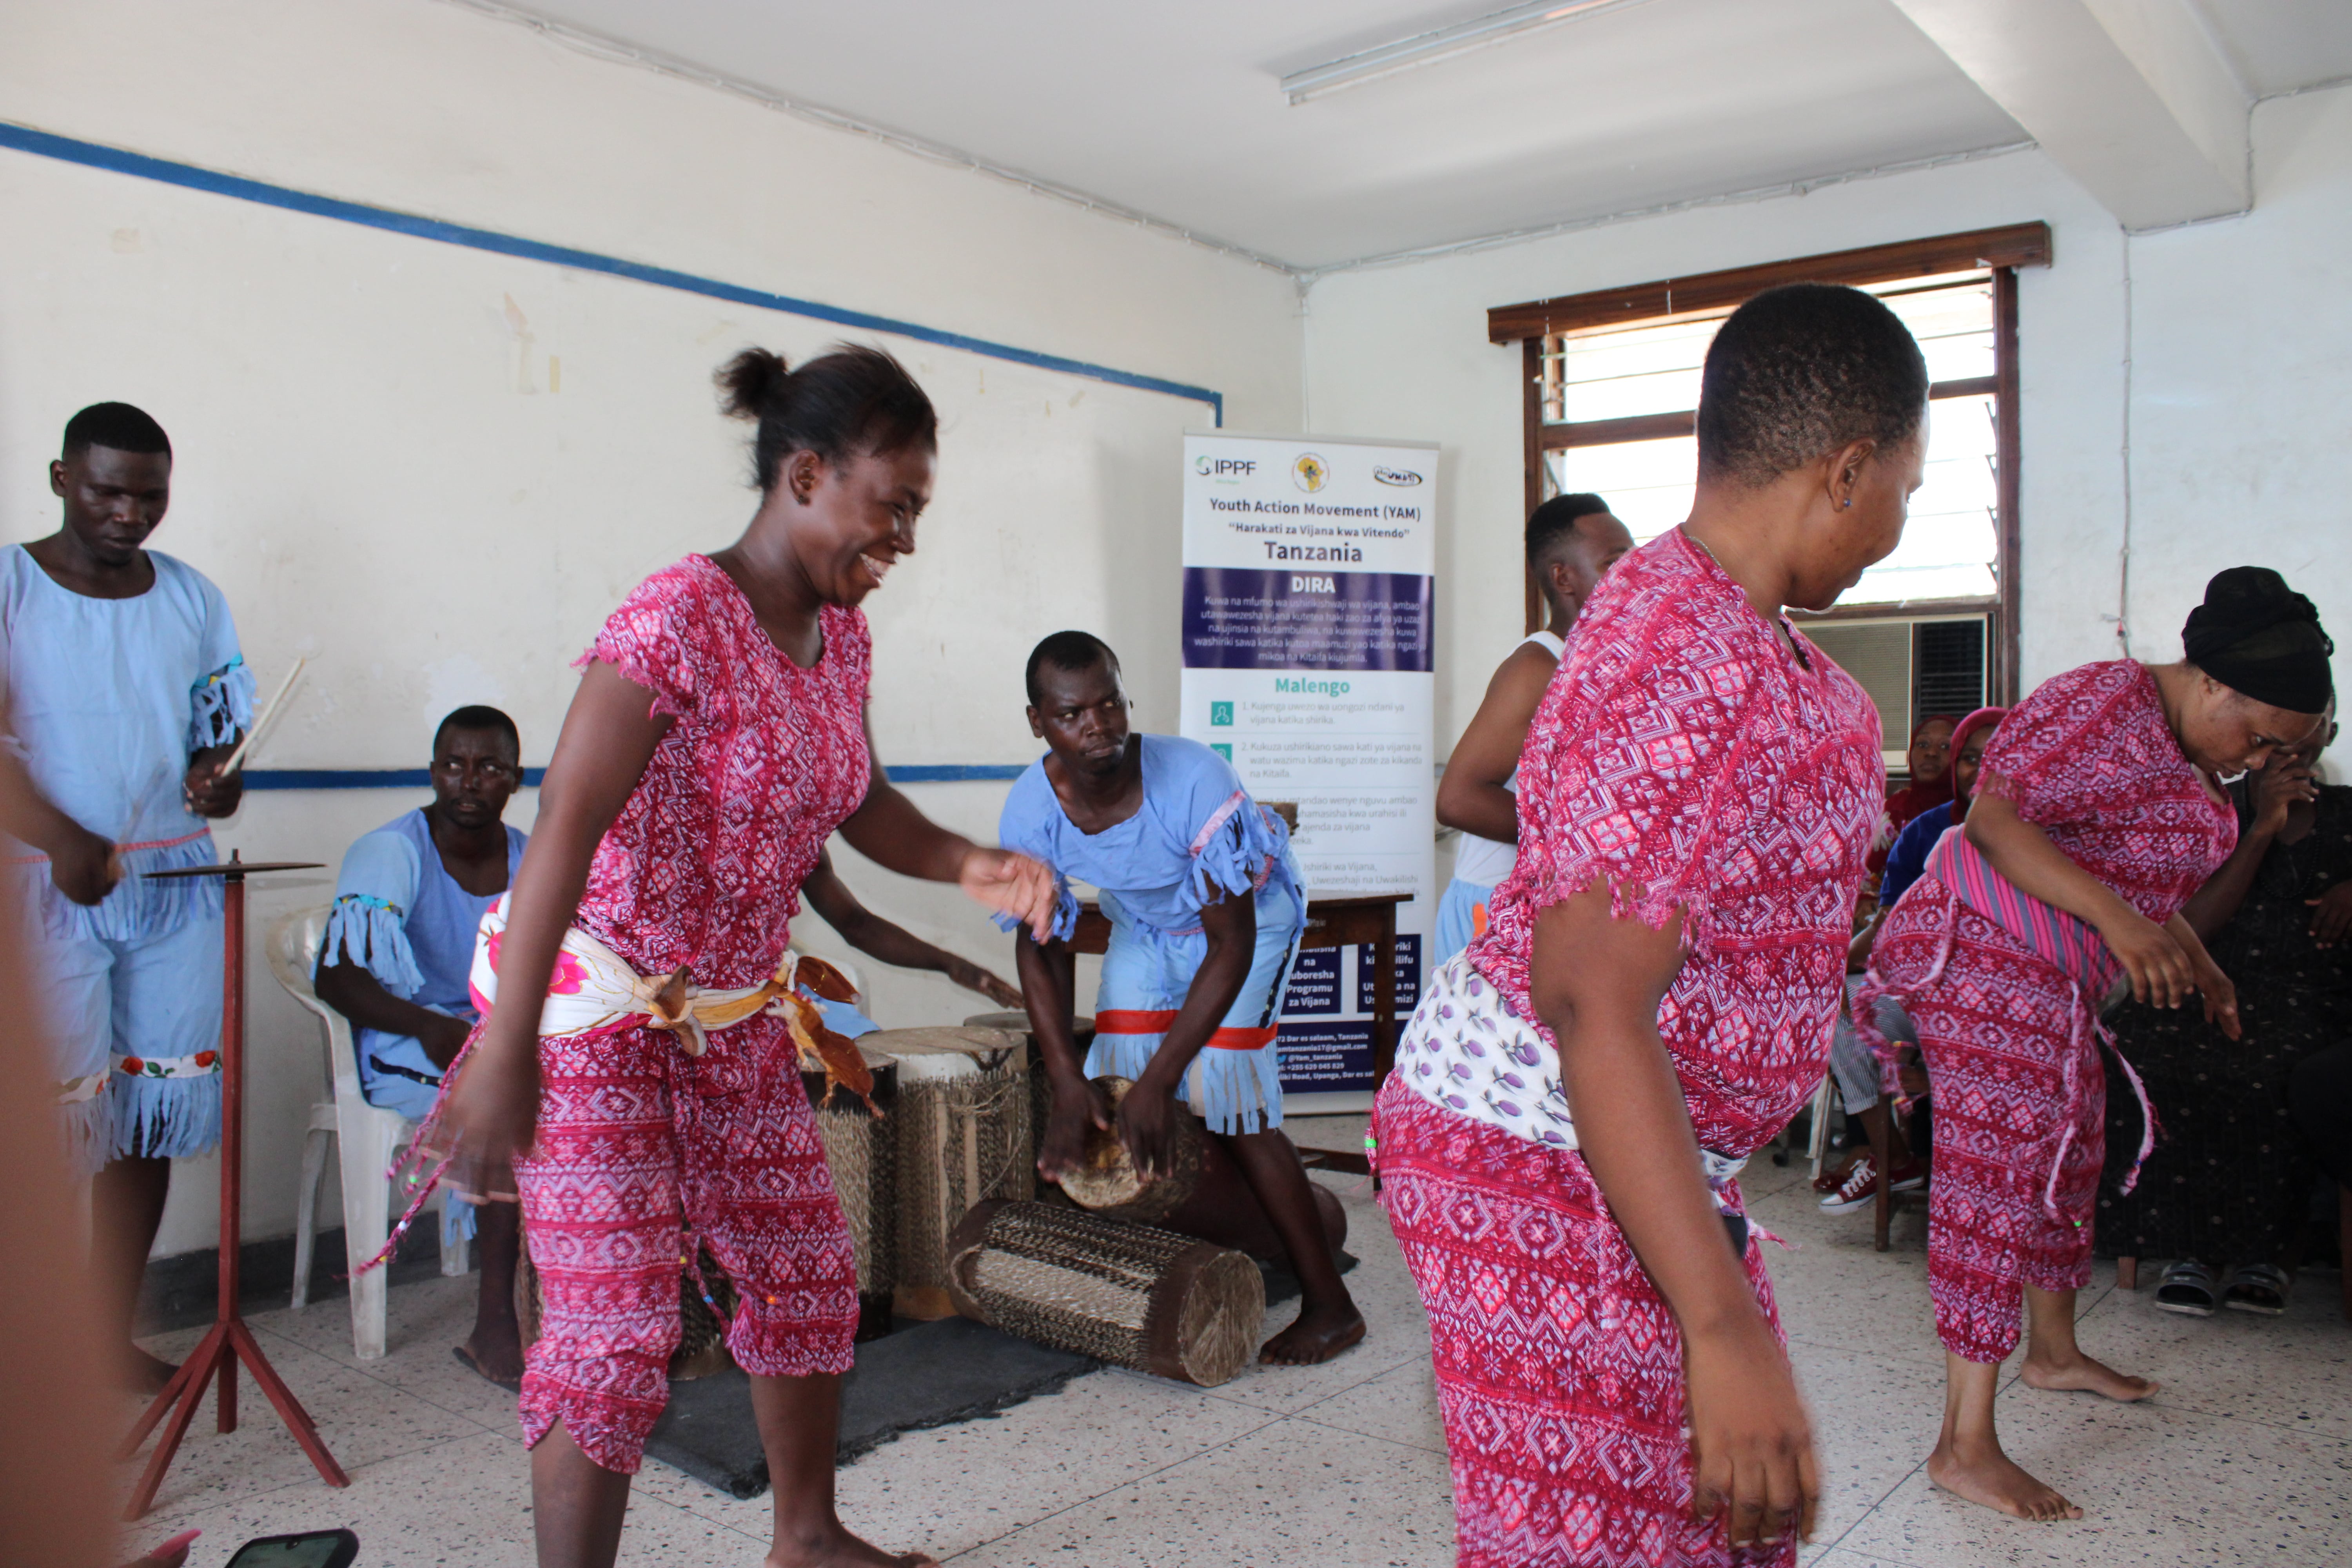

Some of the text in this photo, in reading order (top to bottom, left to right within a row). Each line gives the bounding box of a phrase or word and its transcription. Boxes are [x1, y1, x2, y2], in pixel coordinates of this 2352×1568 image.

[1215, 459, 1256, 475] IPPF
[1210, 498, 1421, 522] Youth Action Movement (YAM)
[1229, 522, 1282, 534] “Harakati
[1300, 525, 1334, 537] Vijana
[1338, 526, 1359, 537] kwa
[1362, 528, 1410, 539] Vitendo”
[1265, 541, 1362, 562] Tanzania
[1293, 576, 1336, 593] DIRA
[1205, 596, 1229, 606] Kuwa
[1243, 597, 1273, 607] mfumo
[1290, 596, 1347, 610] ushirikishwaji
[1393, 601, 1420, 610] ambao
[1201, 610, 1263, 621] utawawezesha
[1264, 612, 1290, 622] vijana
[1292, 612, 1324, 622] kutetea
[1326, 613, 1343, 622] haki
[1374, 613, 1392, 624] afya
[1394, 615, 1402, 625] ya
[1208, 624, 1220, 633] na
[1221, 623, 1249, 635] ujinsia
[1336, 626, 1394, 636] kuwawezesha
[1397, 628, 1417, 637] kuwa
[1194, 637, 1233, 647] washiriki
[1235, 639, 1256, 647] sawa
[1258, 637, 1283, 648] katika
[1285, 638, 1310, 648] kutoa
[1312, 640, 1351, 650] maamuzi
[1353, 642, 1368, 652] yao
[1370, 640, 1396, 650] katika
[1398, 641, 1417, 653] ngazi
[1258, 652, 1285, 662] mikoa
[1299, 652, 1327, 662] Kitaifa
[1276, 677, 1350, 697] Malengo
[1251, 702, 1286, 713] Kujenga
[1332, 703, 1366, 713] uongozi
[1368, 702, 1393, 711] ndani
[1395, 704, 1405, 714] ya
[1250, 715, 1336, 727] vijana katika shirika.
[1251, 742, 1282, 751] Kukuza
[1284, 742, 1331, 751] ushirikiano
[1357, 742, 1372, 751] kati
[1375, 744, 1385, 753] ya
[1387, 742, 1411, 753] vijana
[1273, 756, 1306, 765] wazima
[1308, 755, 1333, 764] katika
[1336, 756, 1357, 767] ngazi
[1360, 757, 1378, 765] zote
[1392, 755, 1422, 765] kikanda
[1250, 769, 1292, 779] na Kitaifa.
[1330, 797, 1357, 807] wenye
[1359, 797, 1387, 807] nguvu
[1389, 795, 1417, 804] ambao
[1349, 809, 1366, 818] kwa
[1369, 809, 1397, 818] urahisi
[1302, 822, 1331, 834] ajenda
[1345, 823, 1370, 833] vijana
[1348, 862, 1377, 873] Vijana,
[1313, 875, 1360, 886] Uwezeshaji
[1376, 875, 1418, 884] Uwakilishi
[1304, 958, 1316, 966] na
[1291, 970, 1335, 980] uboresha
[1287, 984, 1333, 995] Programu
[1404, 982, 1416, 991] na
[1289, 996, 1330, 1008] za Vijana
[1338, 1033, 1369, 1041] Tanzania
[1278, 1043, 1368, 1053] amtanzania17@gmail.com
